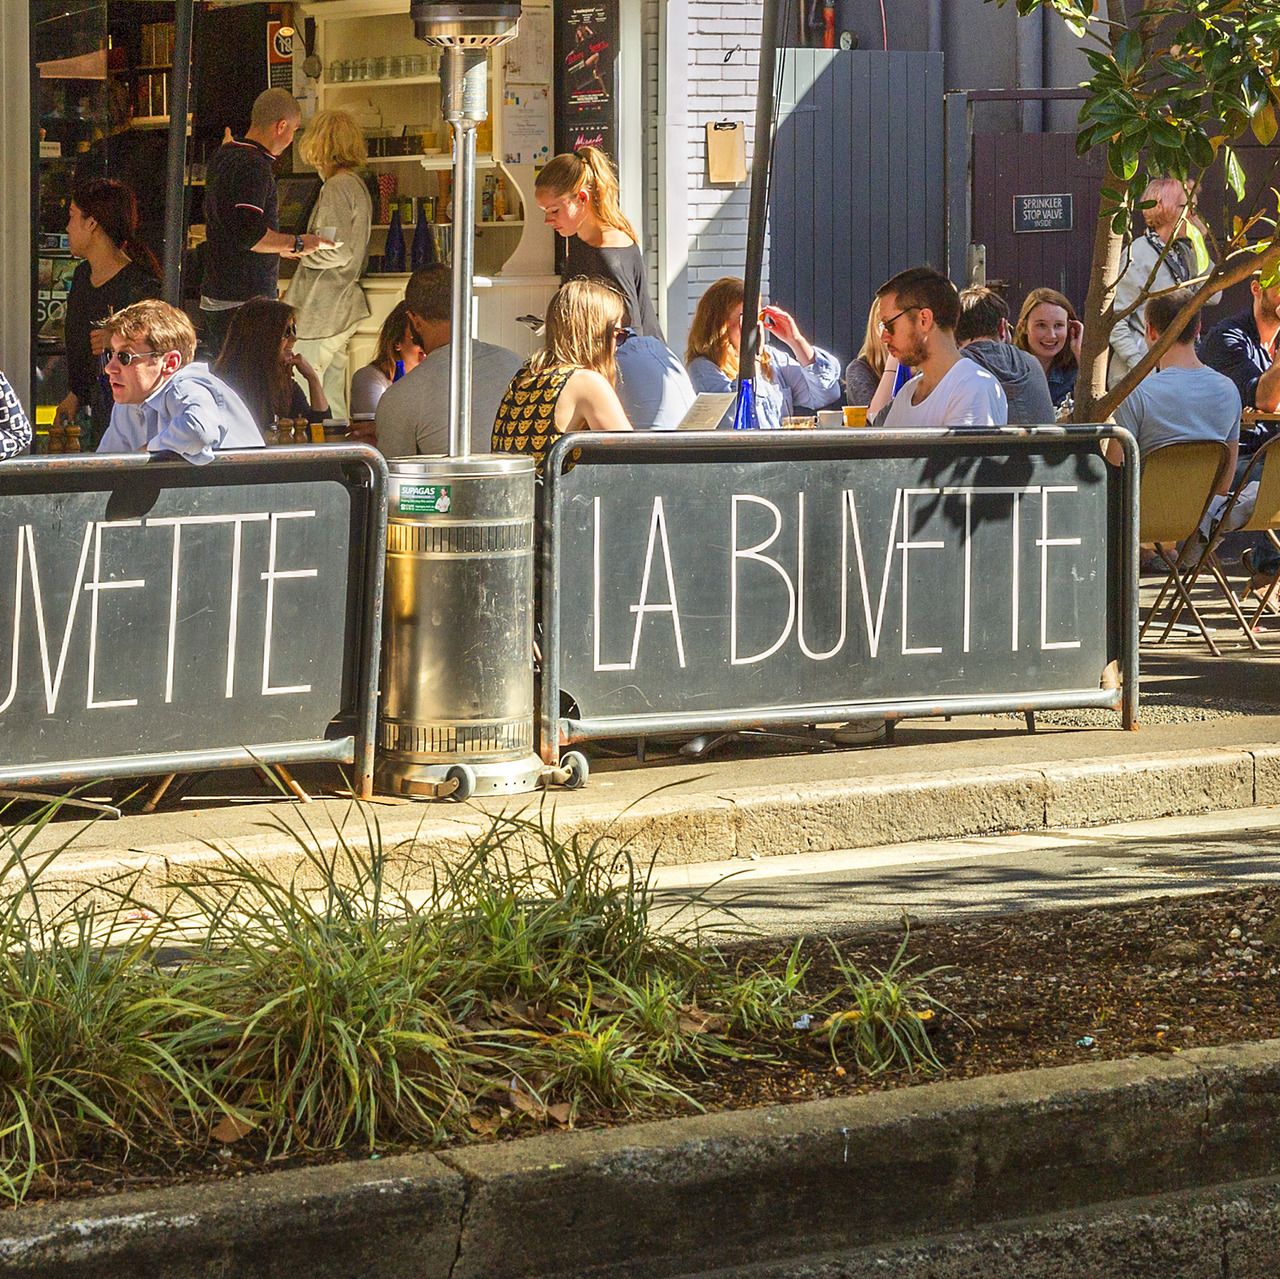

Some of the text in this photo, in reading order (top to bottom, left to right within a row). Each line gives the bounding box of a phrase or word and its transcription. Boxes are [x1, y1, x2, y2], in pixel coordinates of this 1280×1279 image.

[1023, 197, 1063, 209] SPRINKLER
[1023, 208, 1064, 220] STOP VALVE
[1034, 219, 1052, 227] INSIDE
[401, 486, 436, 496] SUPAGAS
[593, 485, 1083, 671] LA BUVETTE
